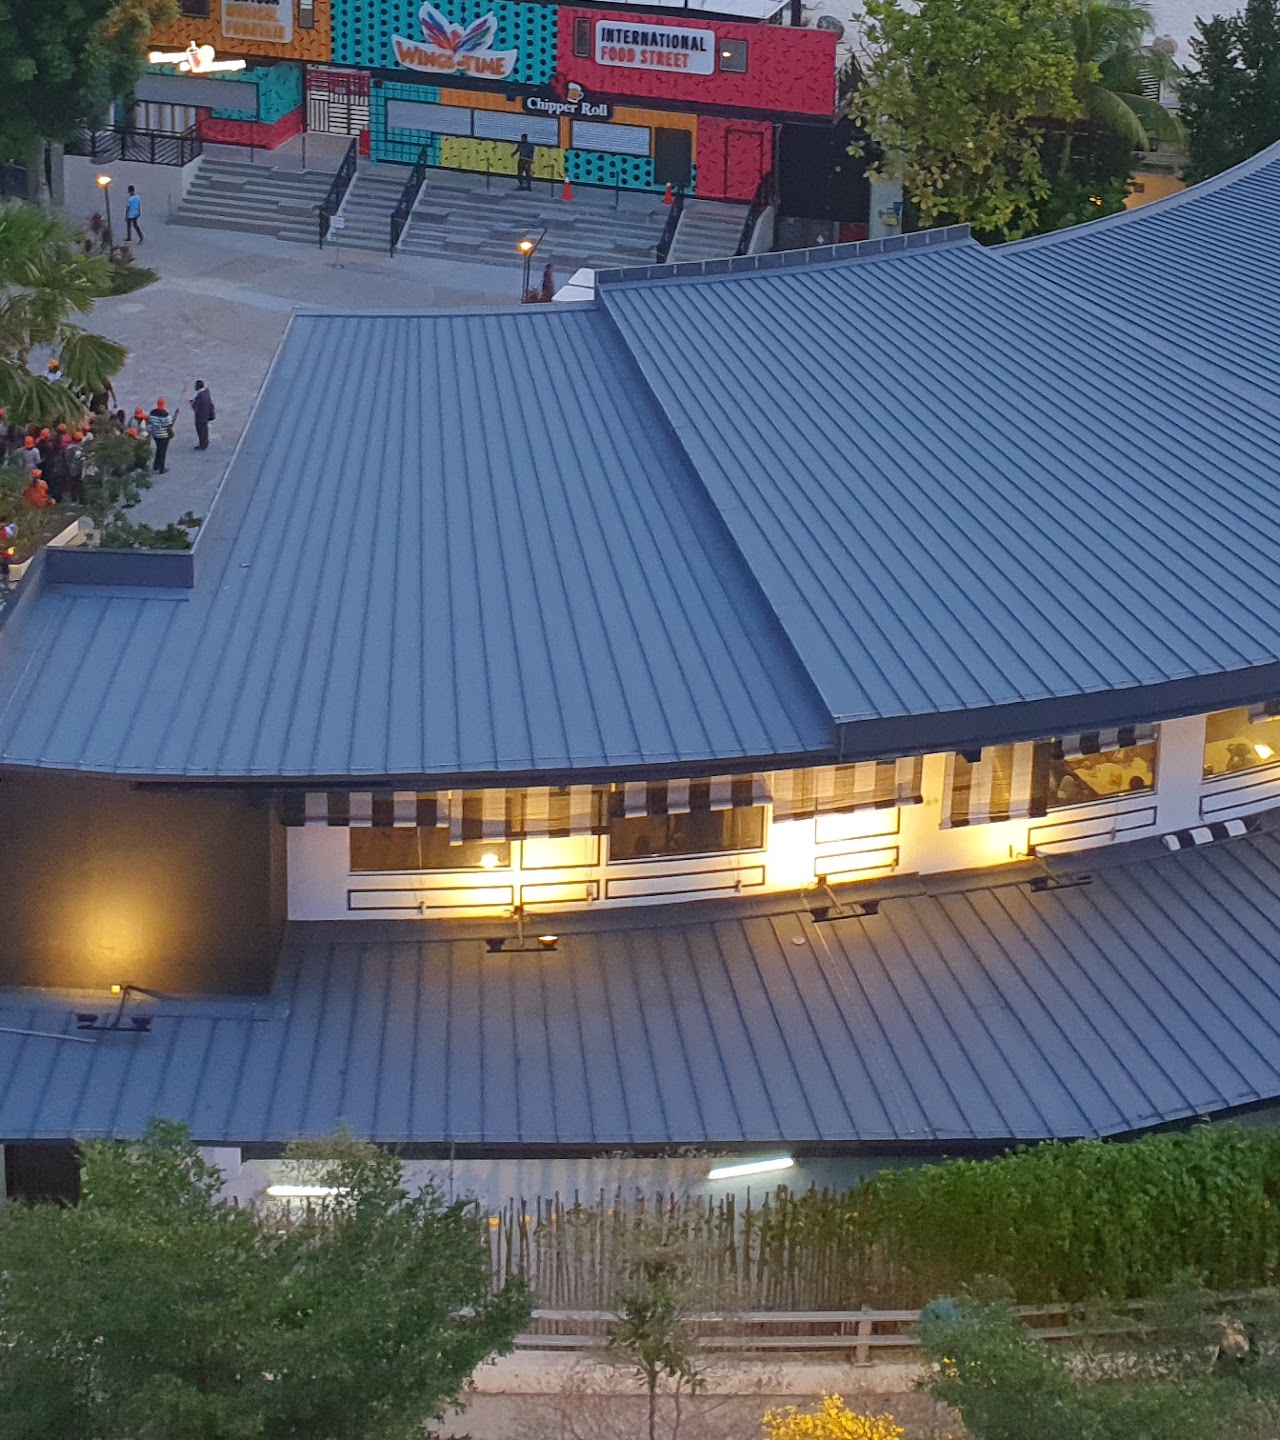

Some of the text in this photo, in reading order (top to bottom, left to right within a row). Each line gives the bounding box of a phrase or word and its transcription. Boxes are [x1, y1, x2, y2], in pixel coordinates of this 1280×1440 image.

[601, 27, 708, 52] INTERNATIONAL
[601, 46, 690, 68] FOOD STREET
[526, 97, 608, 116] Chipper Roll
